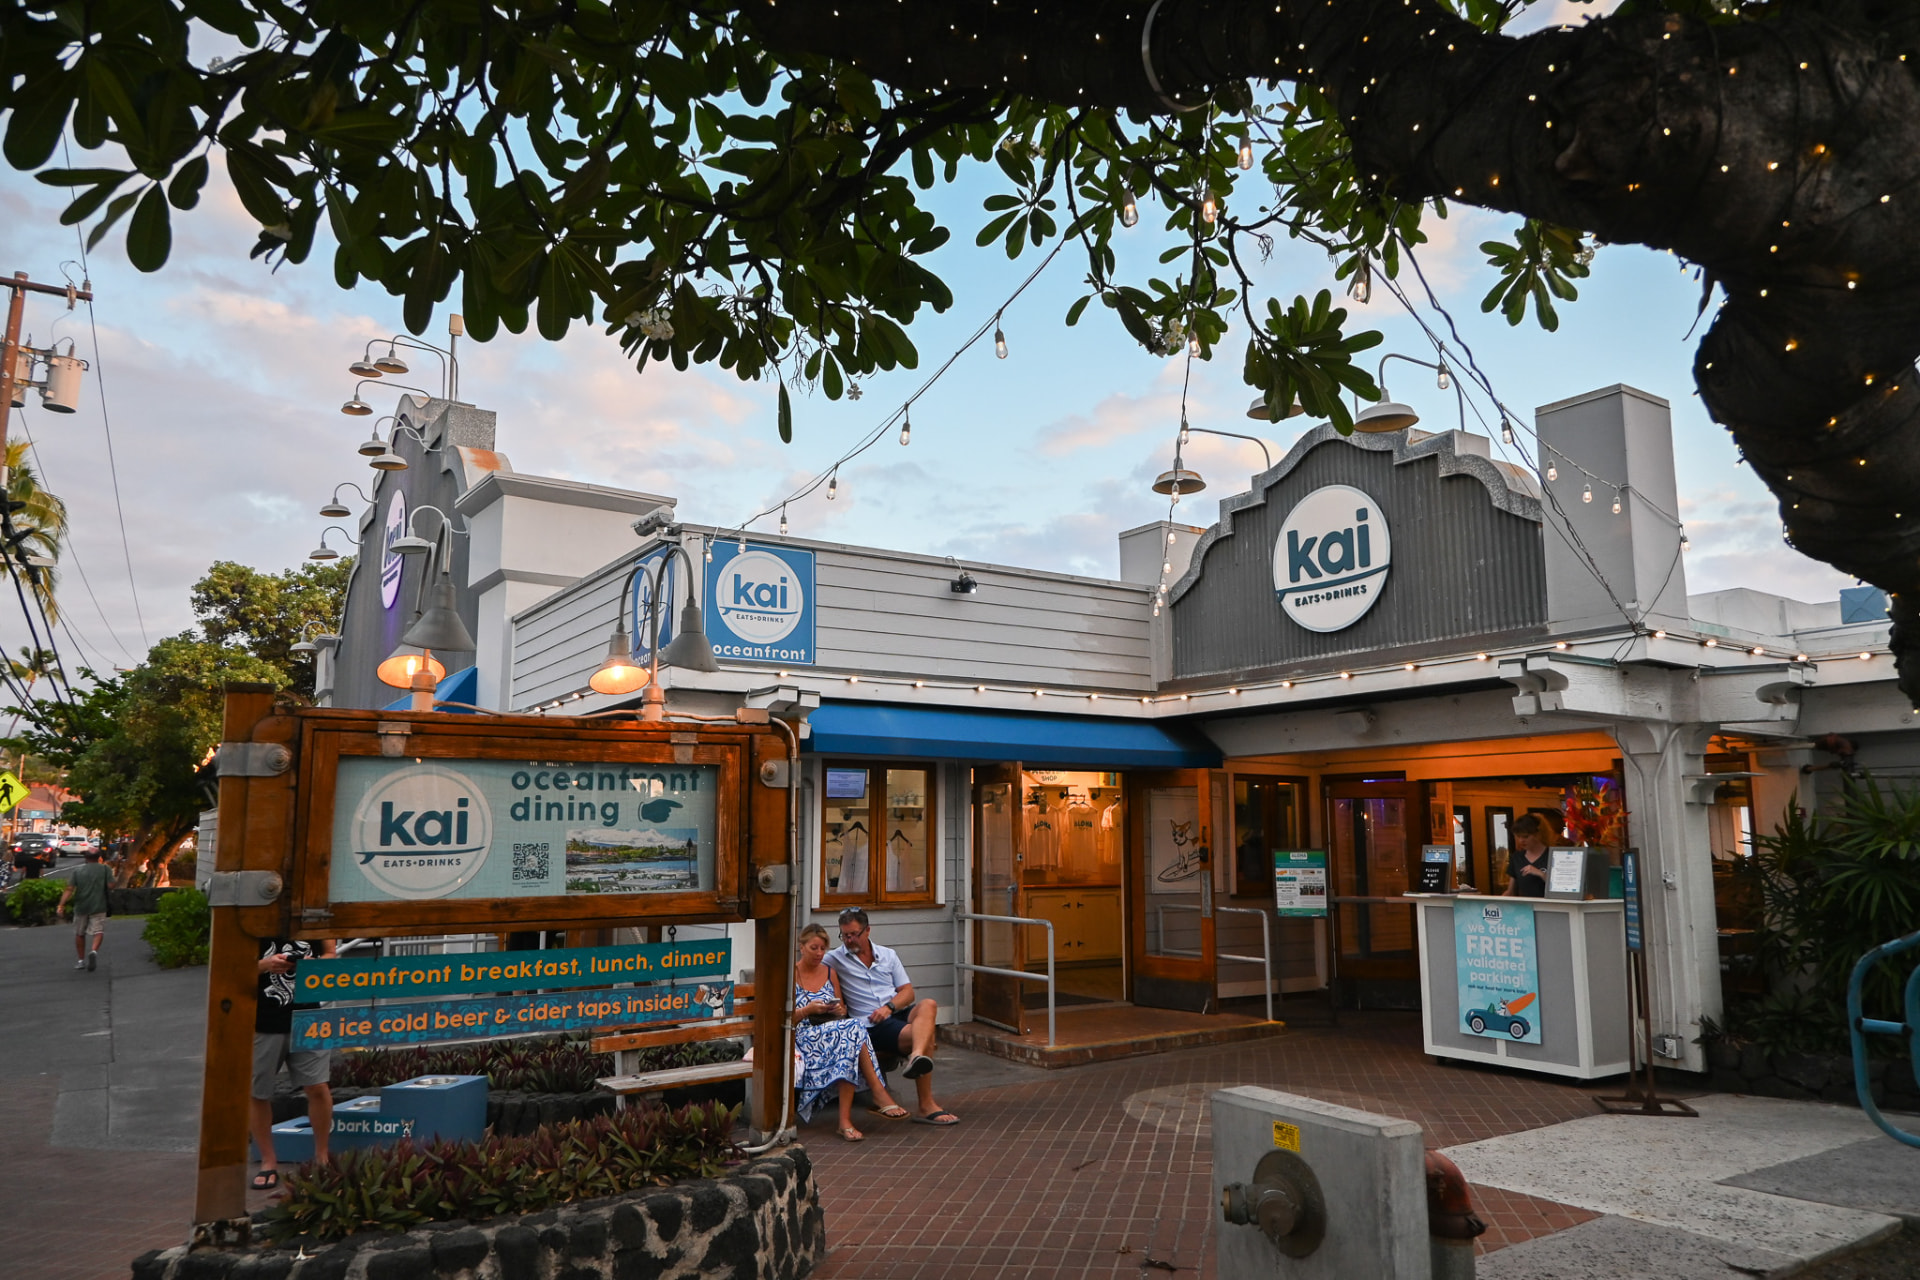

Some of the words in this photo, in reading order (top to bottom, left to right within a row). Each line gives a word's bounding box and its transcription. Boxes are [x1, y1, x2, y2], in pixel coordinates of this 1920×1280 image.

[1287, 507, 1371, 583] kai
[734, 574, 787, 609] kai
[712, 644, 806, 661] oceanfront
[511, 766, 700, 792] oceanfront
[380, 797, 469, 846] kai
[510, 795, 619, 827] dining
[1485, 908, 1499, 917] kai
[1467, 924, 1485, 934] we
[1489, 923, 1520, 936] offer
[1466, 934, 1524, 958] FREE
[304, 965, 452, 989] oceanfront
[460, 958, 583, 982] breakfast,
[590, 953, 654, 973] lunch,
[660, 950, 726, 968] dinner
[1467, 956, 1527, 972] validated
[1470, 971, 1524, 988] parking!
[304, 1021, 332, 1039] 48
[339, 1017, 373, 1036] ice
[379, 1012, 428, 1033] cold
[434, 1011, 489, 1030] beer
[495, 1008, 511, 1024] &
[517, 1003, 573, 1022] cider
[577, 999, 622, 1019] taps
[627, 993, 690, 1013] inside!
[337, 1119, 370, 1133] bark
[374, 1120, 399, 1133] bar
